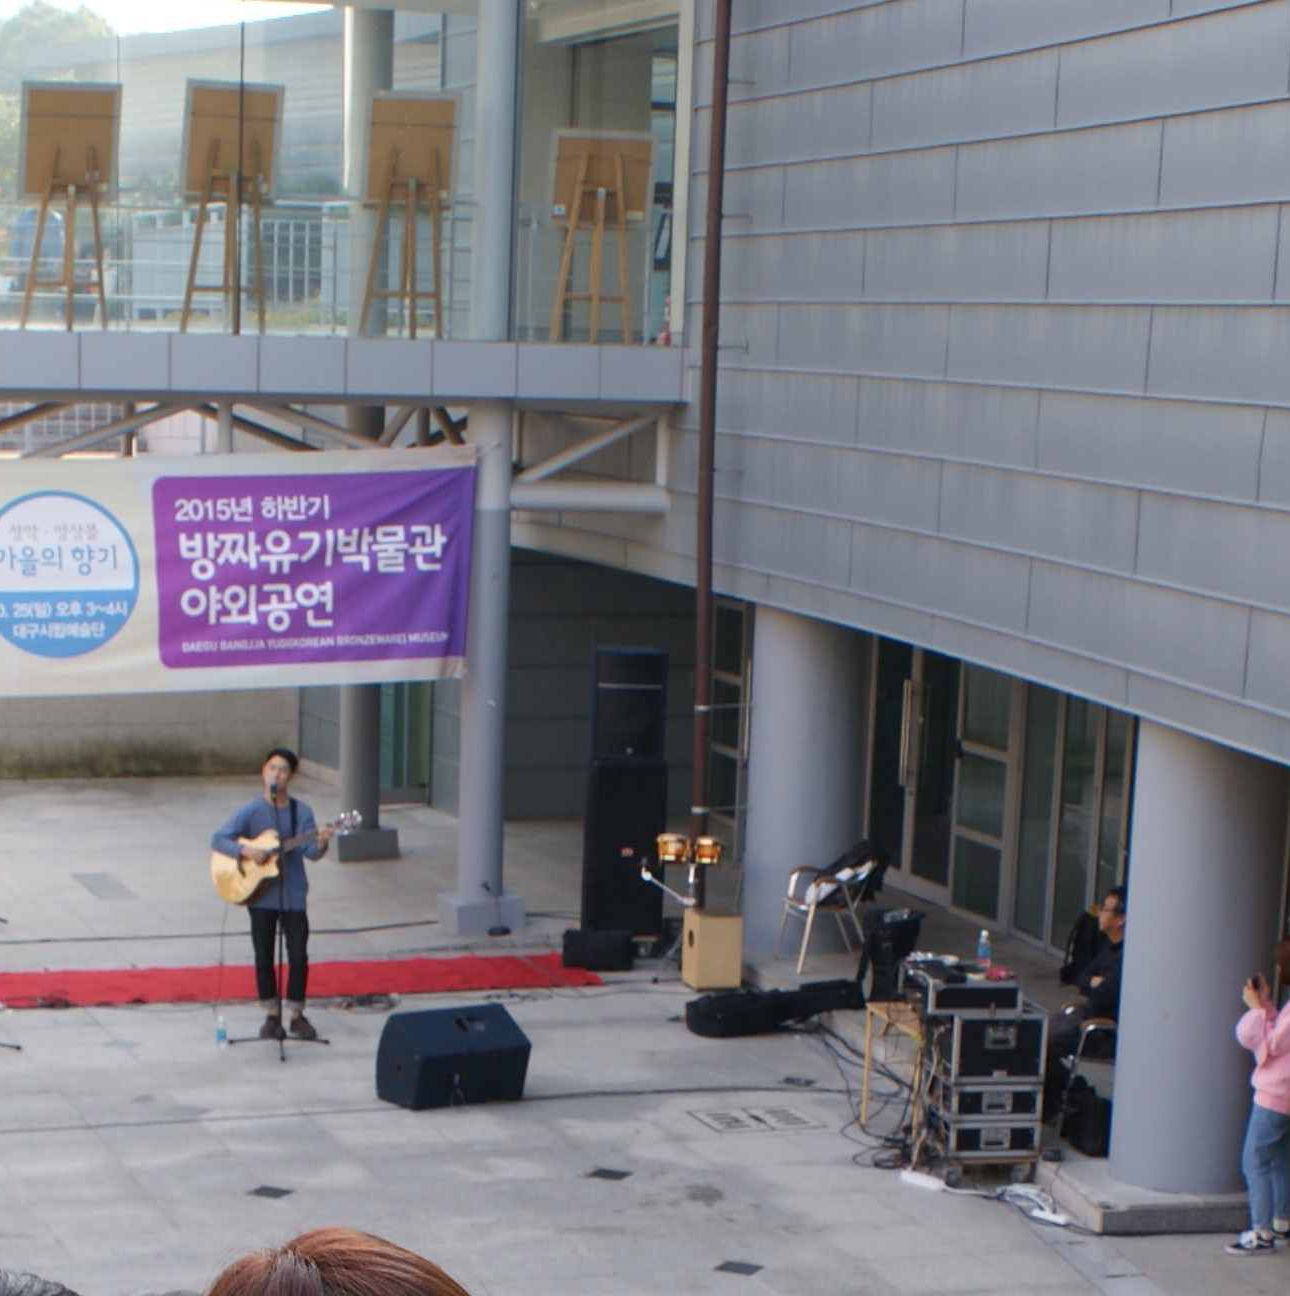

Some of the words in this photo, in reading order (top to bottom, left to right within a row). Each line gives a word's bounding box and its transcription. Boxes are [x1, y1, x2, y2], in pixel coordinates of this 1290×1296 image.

[174, 496, 253, 522] 2015년
[260, 494, 330, 521] 하반기
[71, 544, 118, 577] 향기
[178, 523, 447, 580] 방짜유기박물관
[55, 600, 82, 618] 오후
[180, 581, 334, 633] 야외공연
[182, 640, 218, 653] DAEGU
